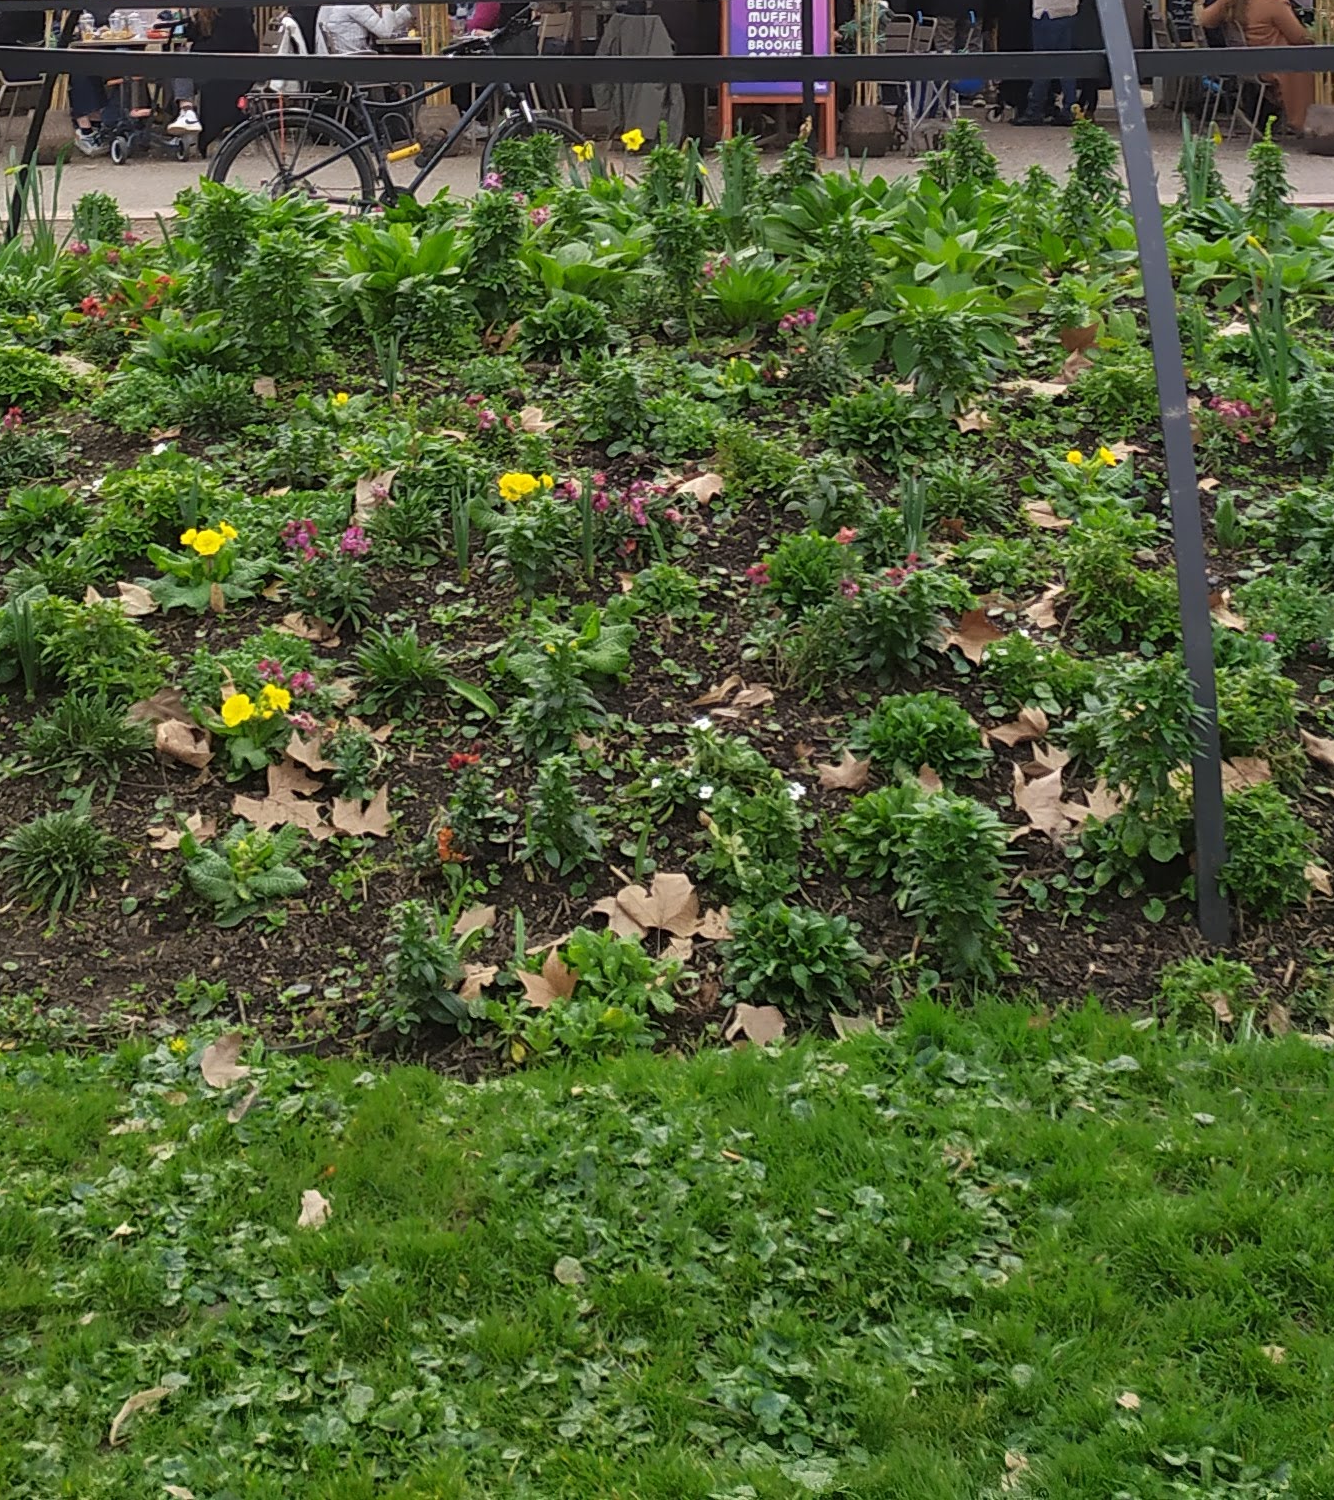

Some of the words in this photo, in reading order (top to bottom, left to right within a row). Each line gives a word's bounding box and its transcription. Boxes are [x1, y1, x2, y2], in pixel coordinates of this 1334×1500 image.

[747, 0, 803, 10] BEIGNET
[748, 11, 801, 23] MUFFIN
[747, 25, 801, 38] DONUT
[747, 40, 803, 50] BROOKIE
